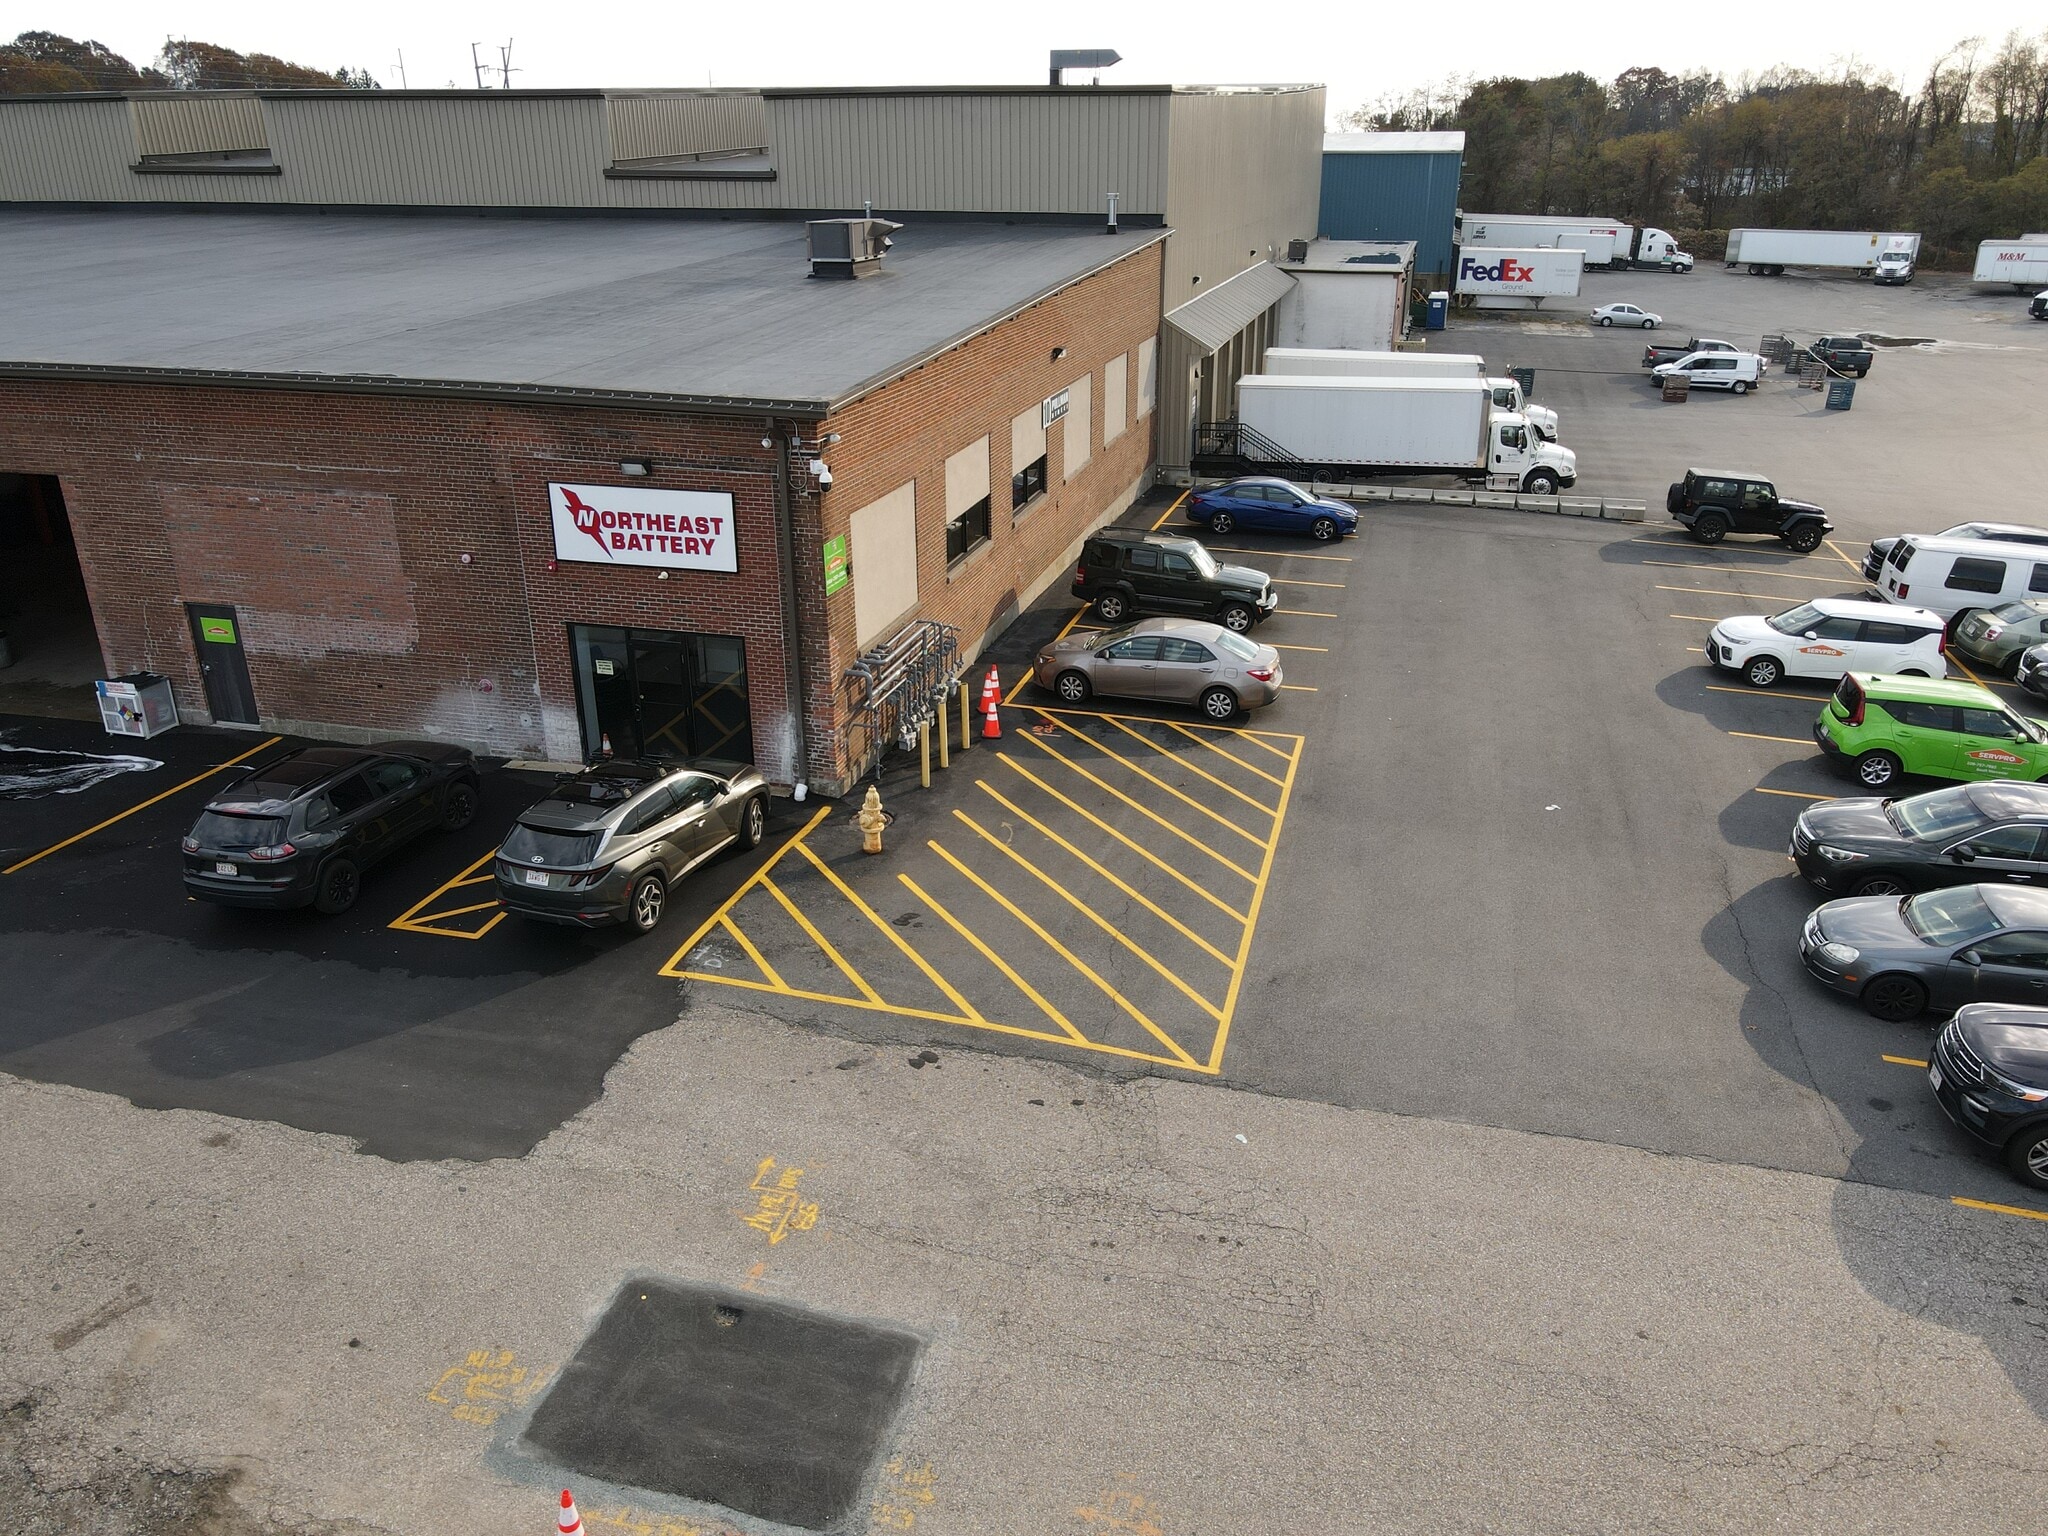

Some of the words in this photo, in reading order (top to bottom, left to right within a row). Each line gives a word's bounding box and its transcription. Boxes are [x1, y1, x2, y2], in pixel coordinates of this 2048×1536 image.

[1460, 257, 1535, 282] FedEx
[577, 510, 724, 536] NORTHEAST
[611, 532, 716, 556] BATTERY
[1807, 648, 1837, 656] SERVPRO
[1979, 752, 2016, 762] SERVPRO
